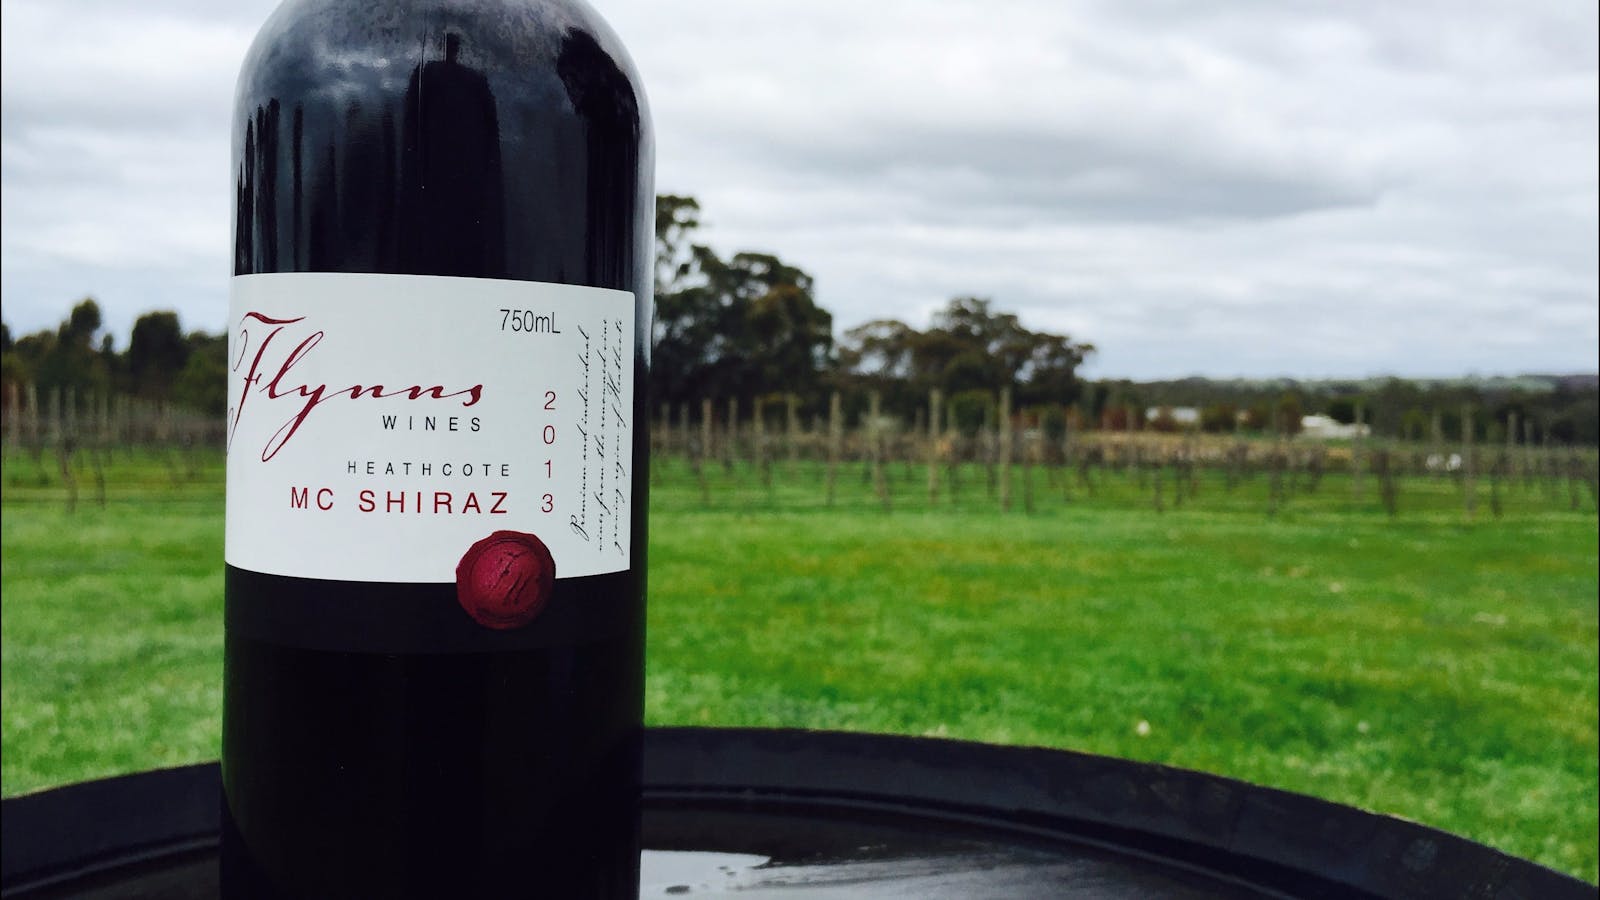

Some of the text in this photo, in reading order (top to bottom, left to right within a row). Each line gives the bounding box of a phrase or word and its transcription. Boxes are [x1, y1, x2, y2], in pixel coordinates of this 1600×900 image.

[499, 308, 562, 335] 750mL
[228, 311, 484, 463] Flynns
[382, 414, 481, 433] WINES
[569, 324, 590, 542] Premium and individual
[594, 434, 605, 461] the
[347, 460, 510, 478] HEATHCOTE
[290, 486, 508, 515] MC SHIRAZ
[593, 467, 612, 516] from
